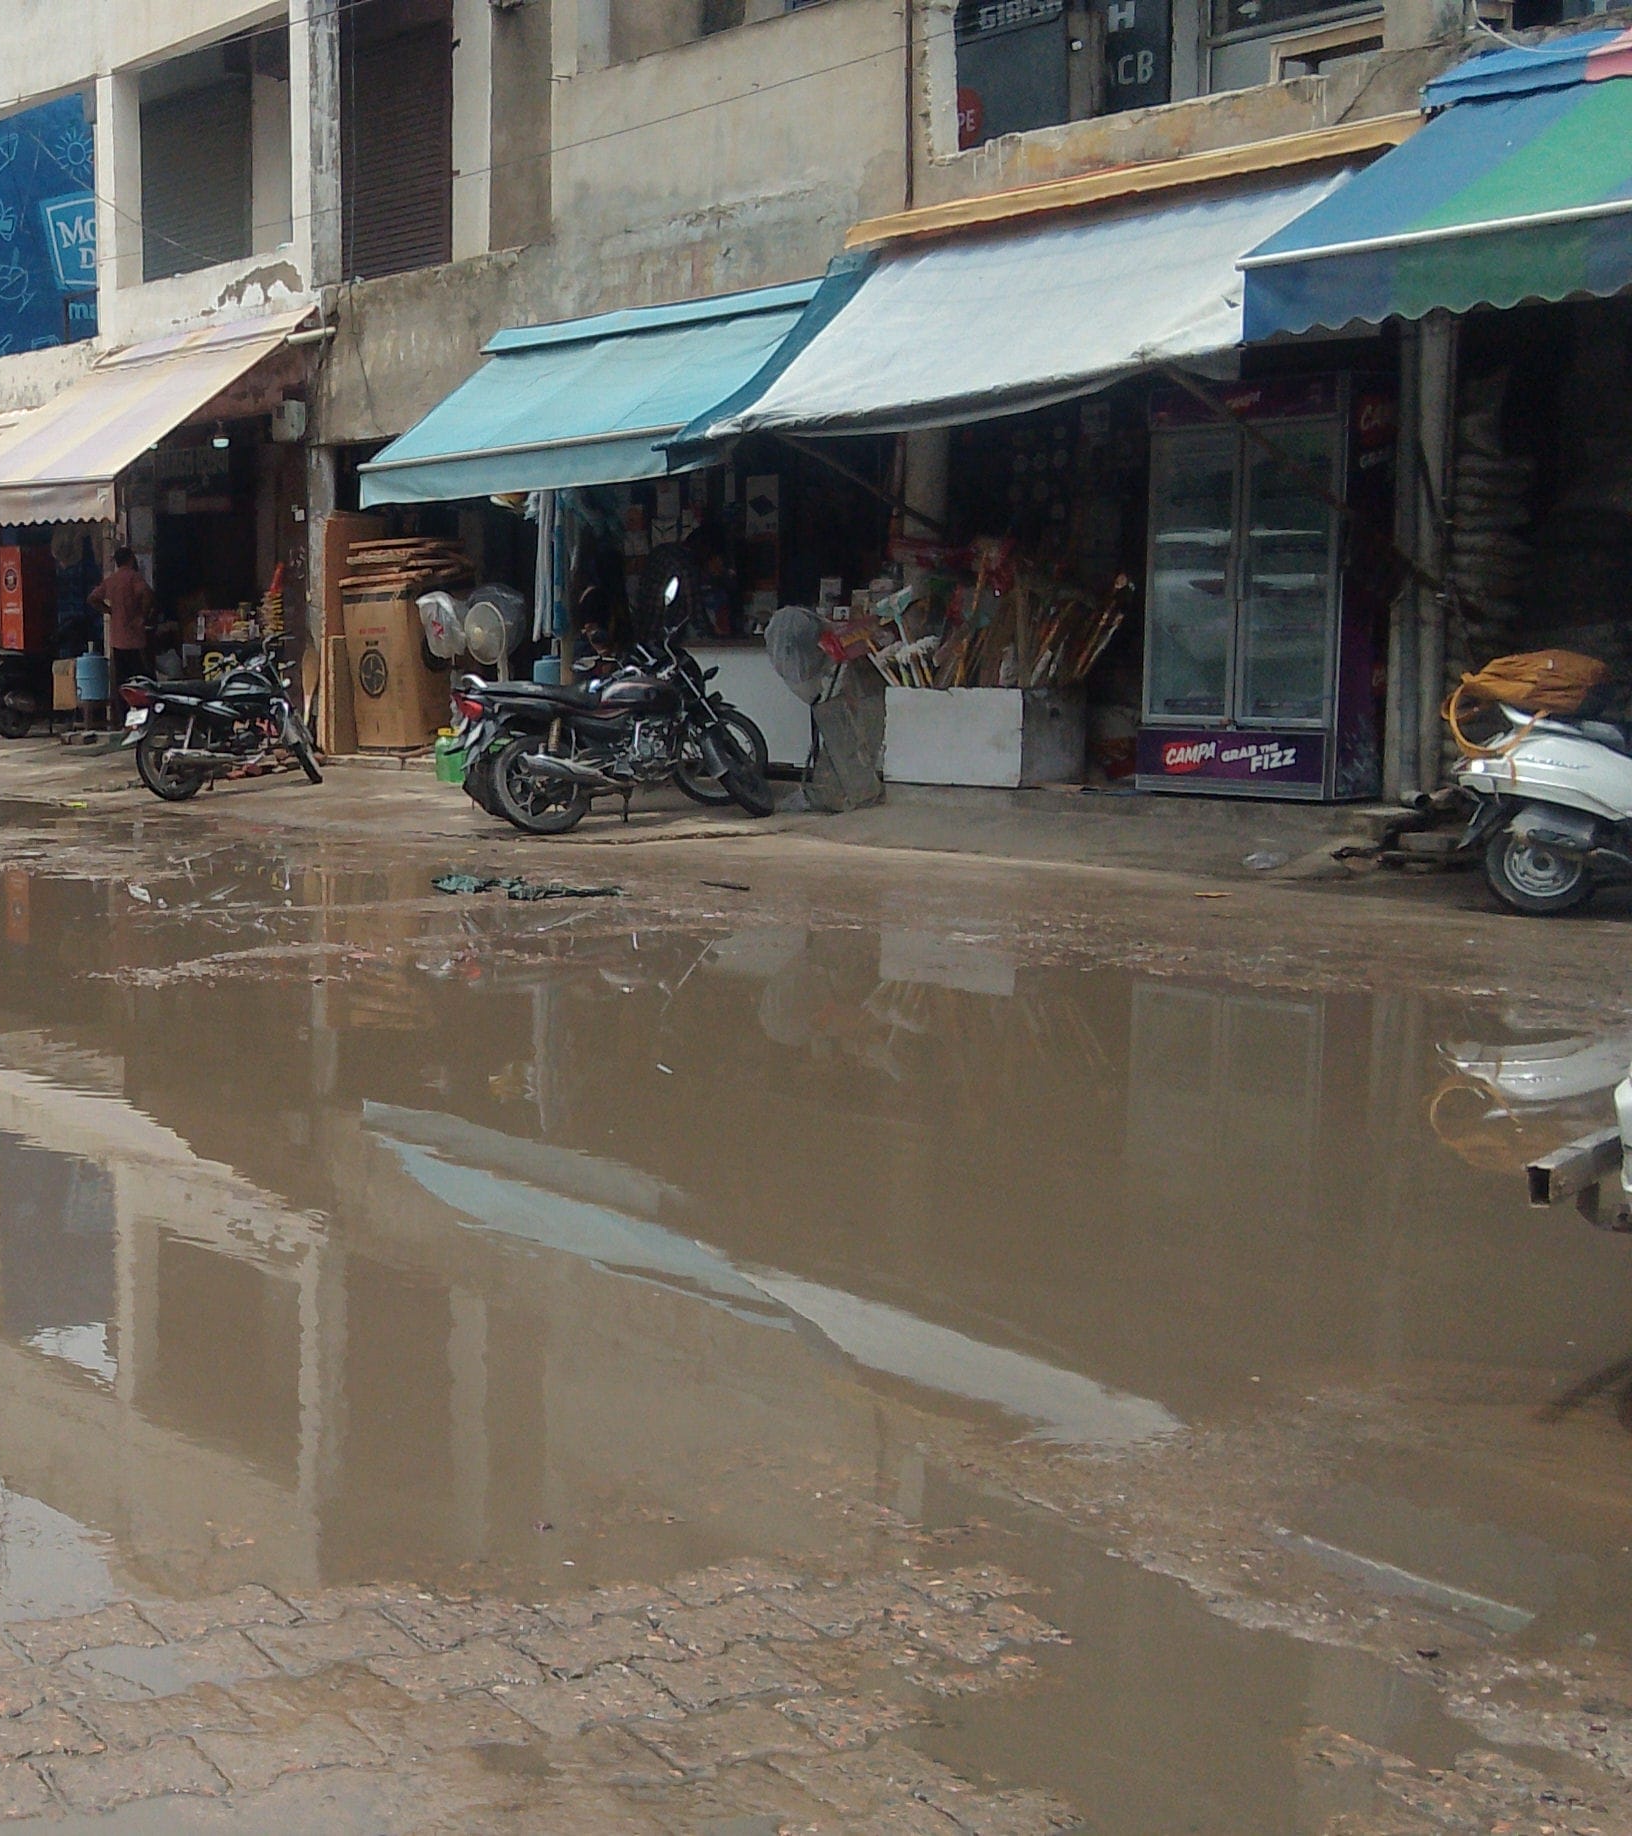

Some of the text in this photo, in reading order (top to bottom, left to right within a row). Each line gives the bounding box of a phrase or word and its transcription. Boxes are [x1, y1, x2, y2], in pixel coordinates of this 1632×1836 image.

[1165, 741, 1217, 765] CAMPA
[1221, 742, 1279, 762] GRAB THE
[1250, 748, 1296, 773] FIZZ
